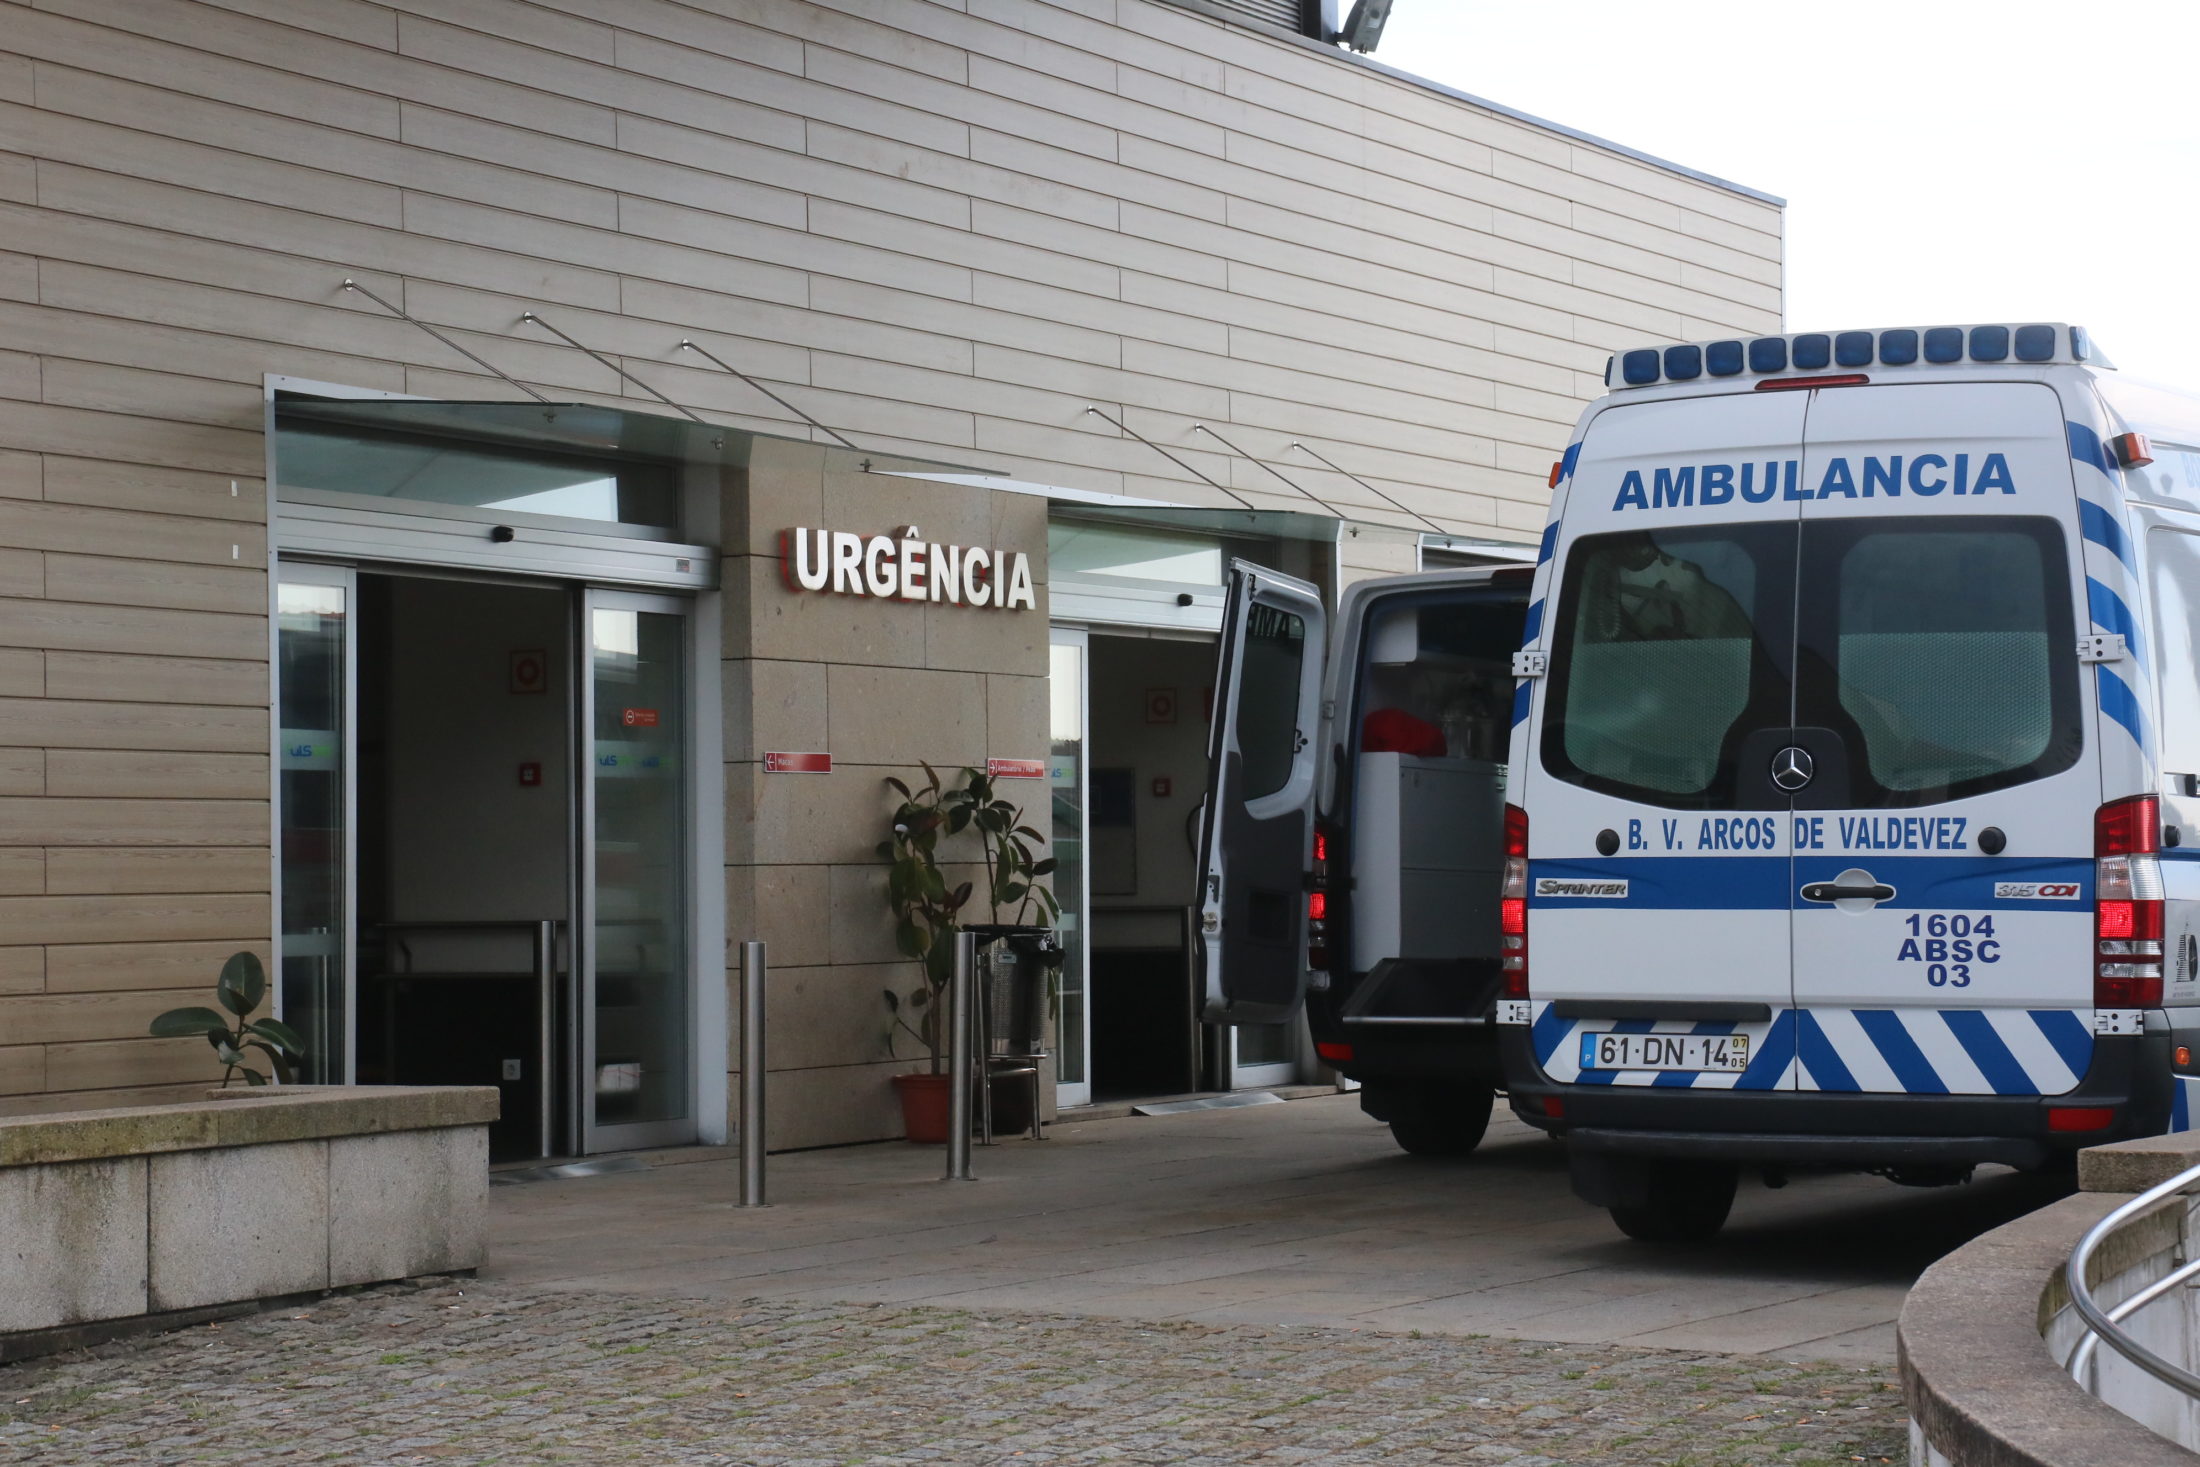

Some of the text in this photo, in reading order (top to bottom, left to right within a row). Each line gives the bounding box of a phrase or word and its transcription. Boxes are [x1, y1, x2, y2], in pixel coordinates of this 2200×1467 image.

[1611, 452, 2017, 511] AMBULANCIA
[796, 525, 1036, 610] URGÊNCIA
[1628, 817, 1967, 850] B. V. ARCOS DE VALDEVEZ
[1537, 879, 1627, 895] SPRINTER
[1996, 884, 2079, 897] 315 CDI
[1905, 913, 1995, 938] 1604
[1896, 938, 2001, 964] ABSC
[1927, 963, 1971, 988] 03
[1732, 1038, 1747, 1048] 07
